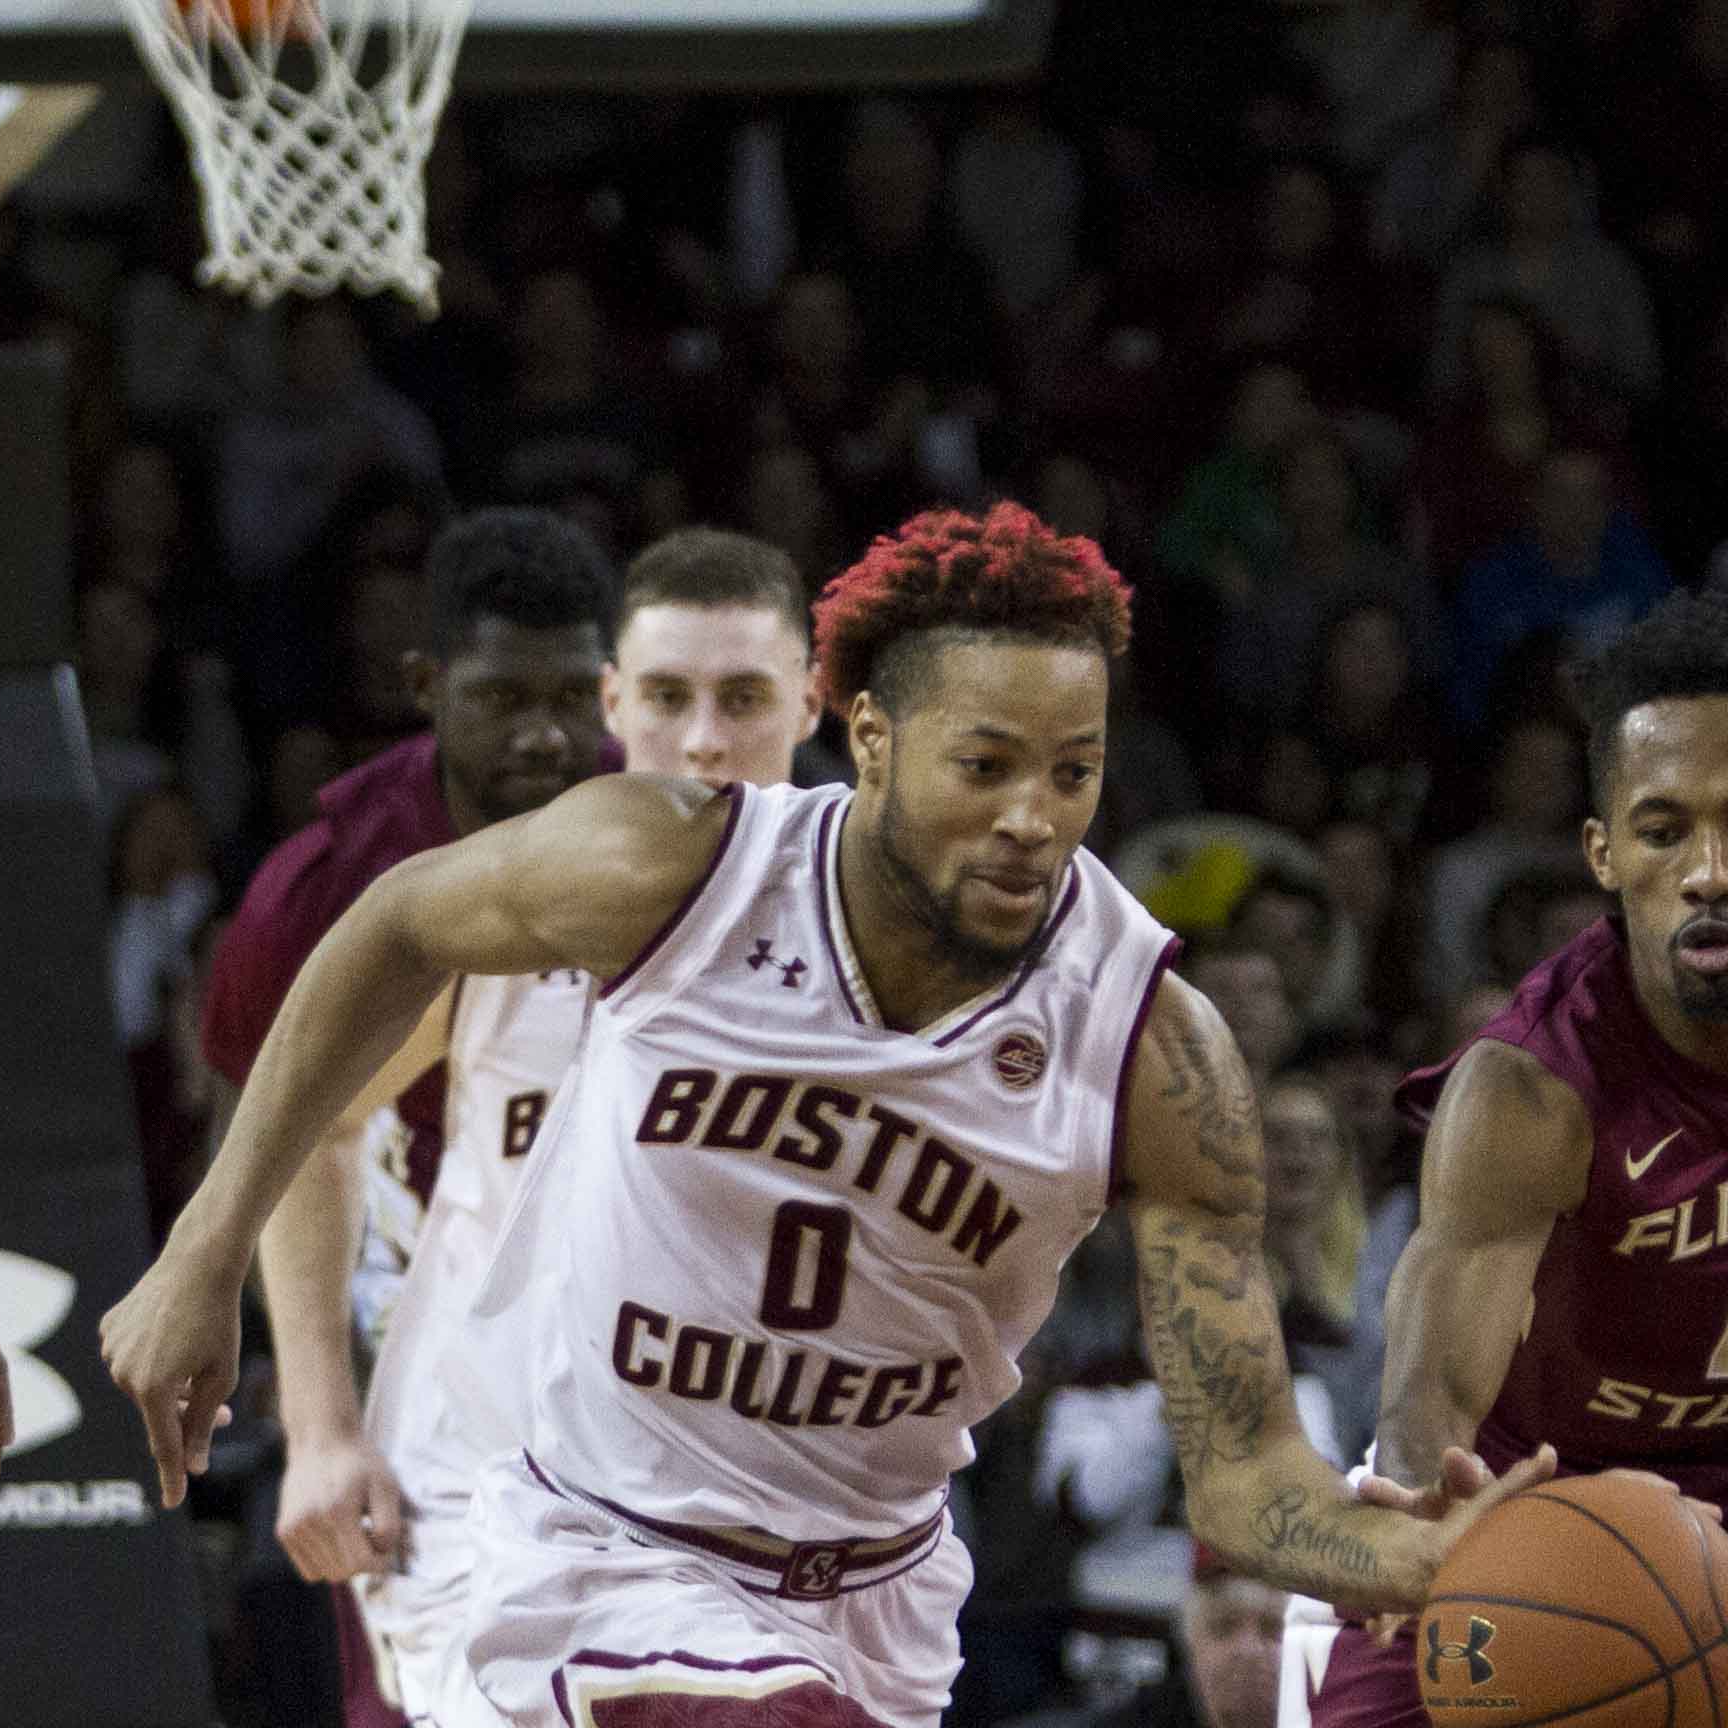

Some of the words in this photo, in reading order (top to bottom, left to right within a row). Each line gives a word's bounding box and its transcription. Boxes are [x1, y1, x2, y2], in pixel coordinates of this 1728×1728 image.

[636, 1069, 1022, 1268] BOSTON
[759, 1200, 852, 1331] 0
[612, 1300, 964, 1429] COLLEGE
